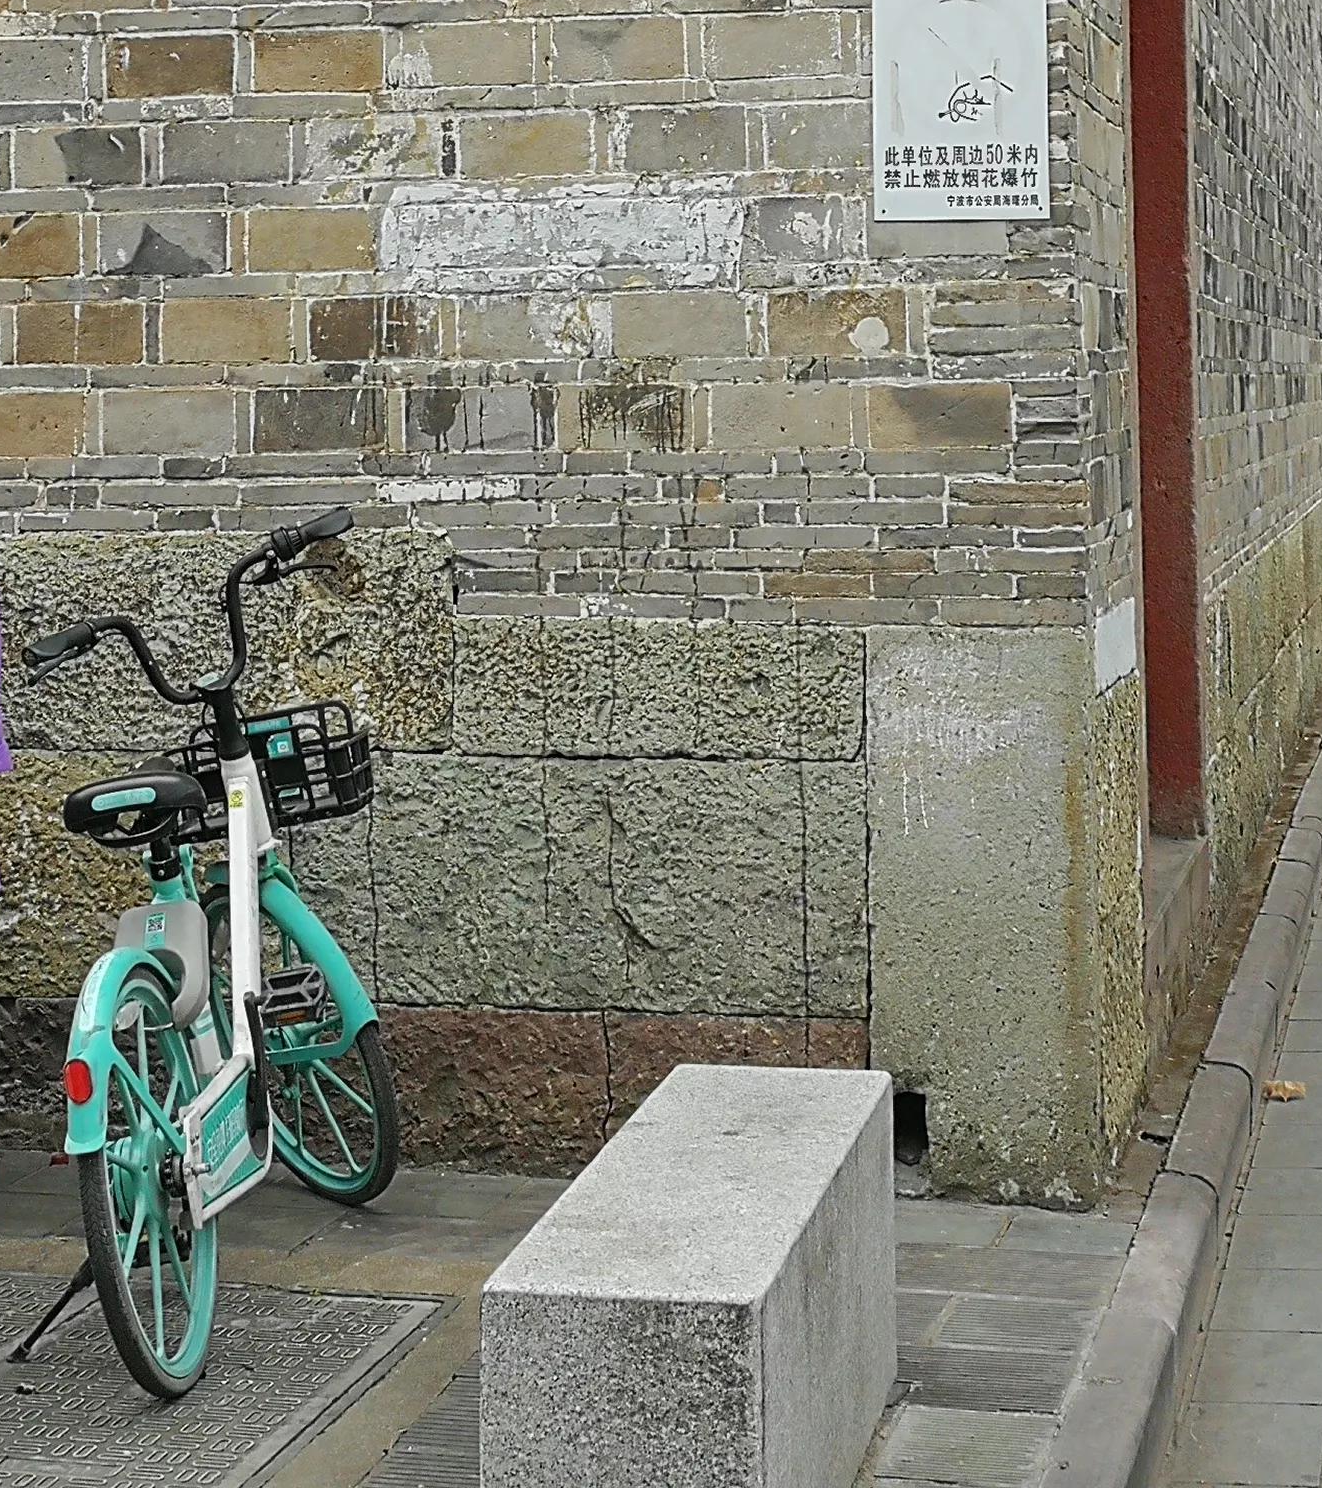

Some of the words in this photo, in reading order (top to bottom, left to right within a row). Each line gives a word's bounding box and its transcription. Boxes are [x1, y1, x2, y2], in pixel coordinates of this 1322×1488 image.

[884, 144, 1039, 166] 此单位及周边50米内
[884, 167, 1039, 189] 禁止燃放烟花爆竹
[946, 194, 1039, 208] 宁波市公安局海曙分局
